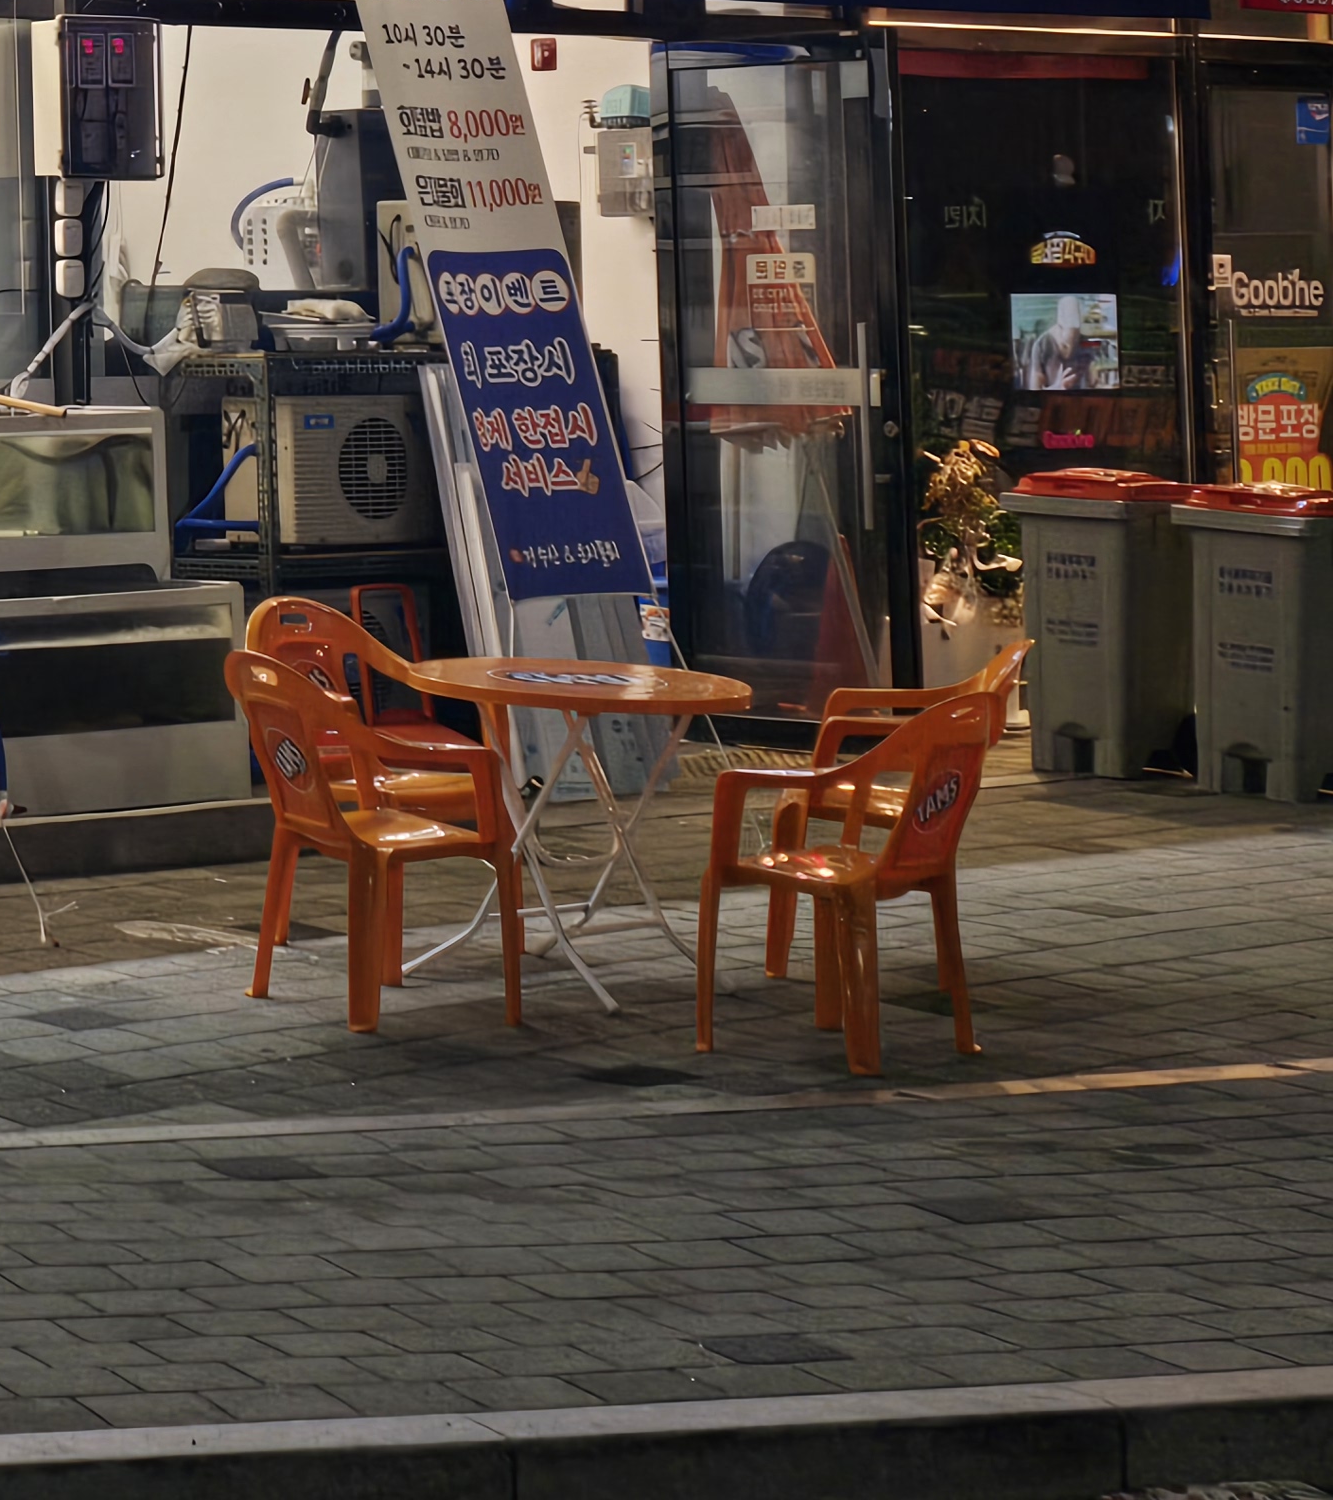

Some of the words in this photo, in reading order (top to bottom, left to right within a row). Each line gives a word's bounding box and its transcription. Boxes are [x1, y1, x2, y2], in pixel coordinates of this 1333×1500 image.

[382, 22, 418, 46] 10시
[422, 24, 465, 48] 30분
[457, 55, 506, 80] 30분
[447, 109, 526, 143] 8,000원
[467, 178, 544, 212] 11,000원
[441, 273, 568, 313] 포장이벤트
[484, 337, 575, 387] 포장시
[1238, 403, 1321, 442] 방문포장
[501, 452, 581, 497] 서비스
